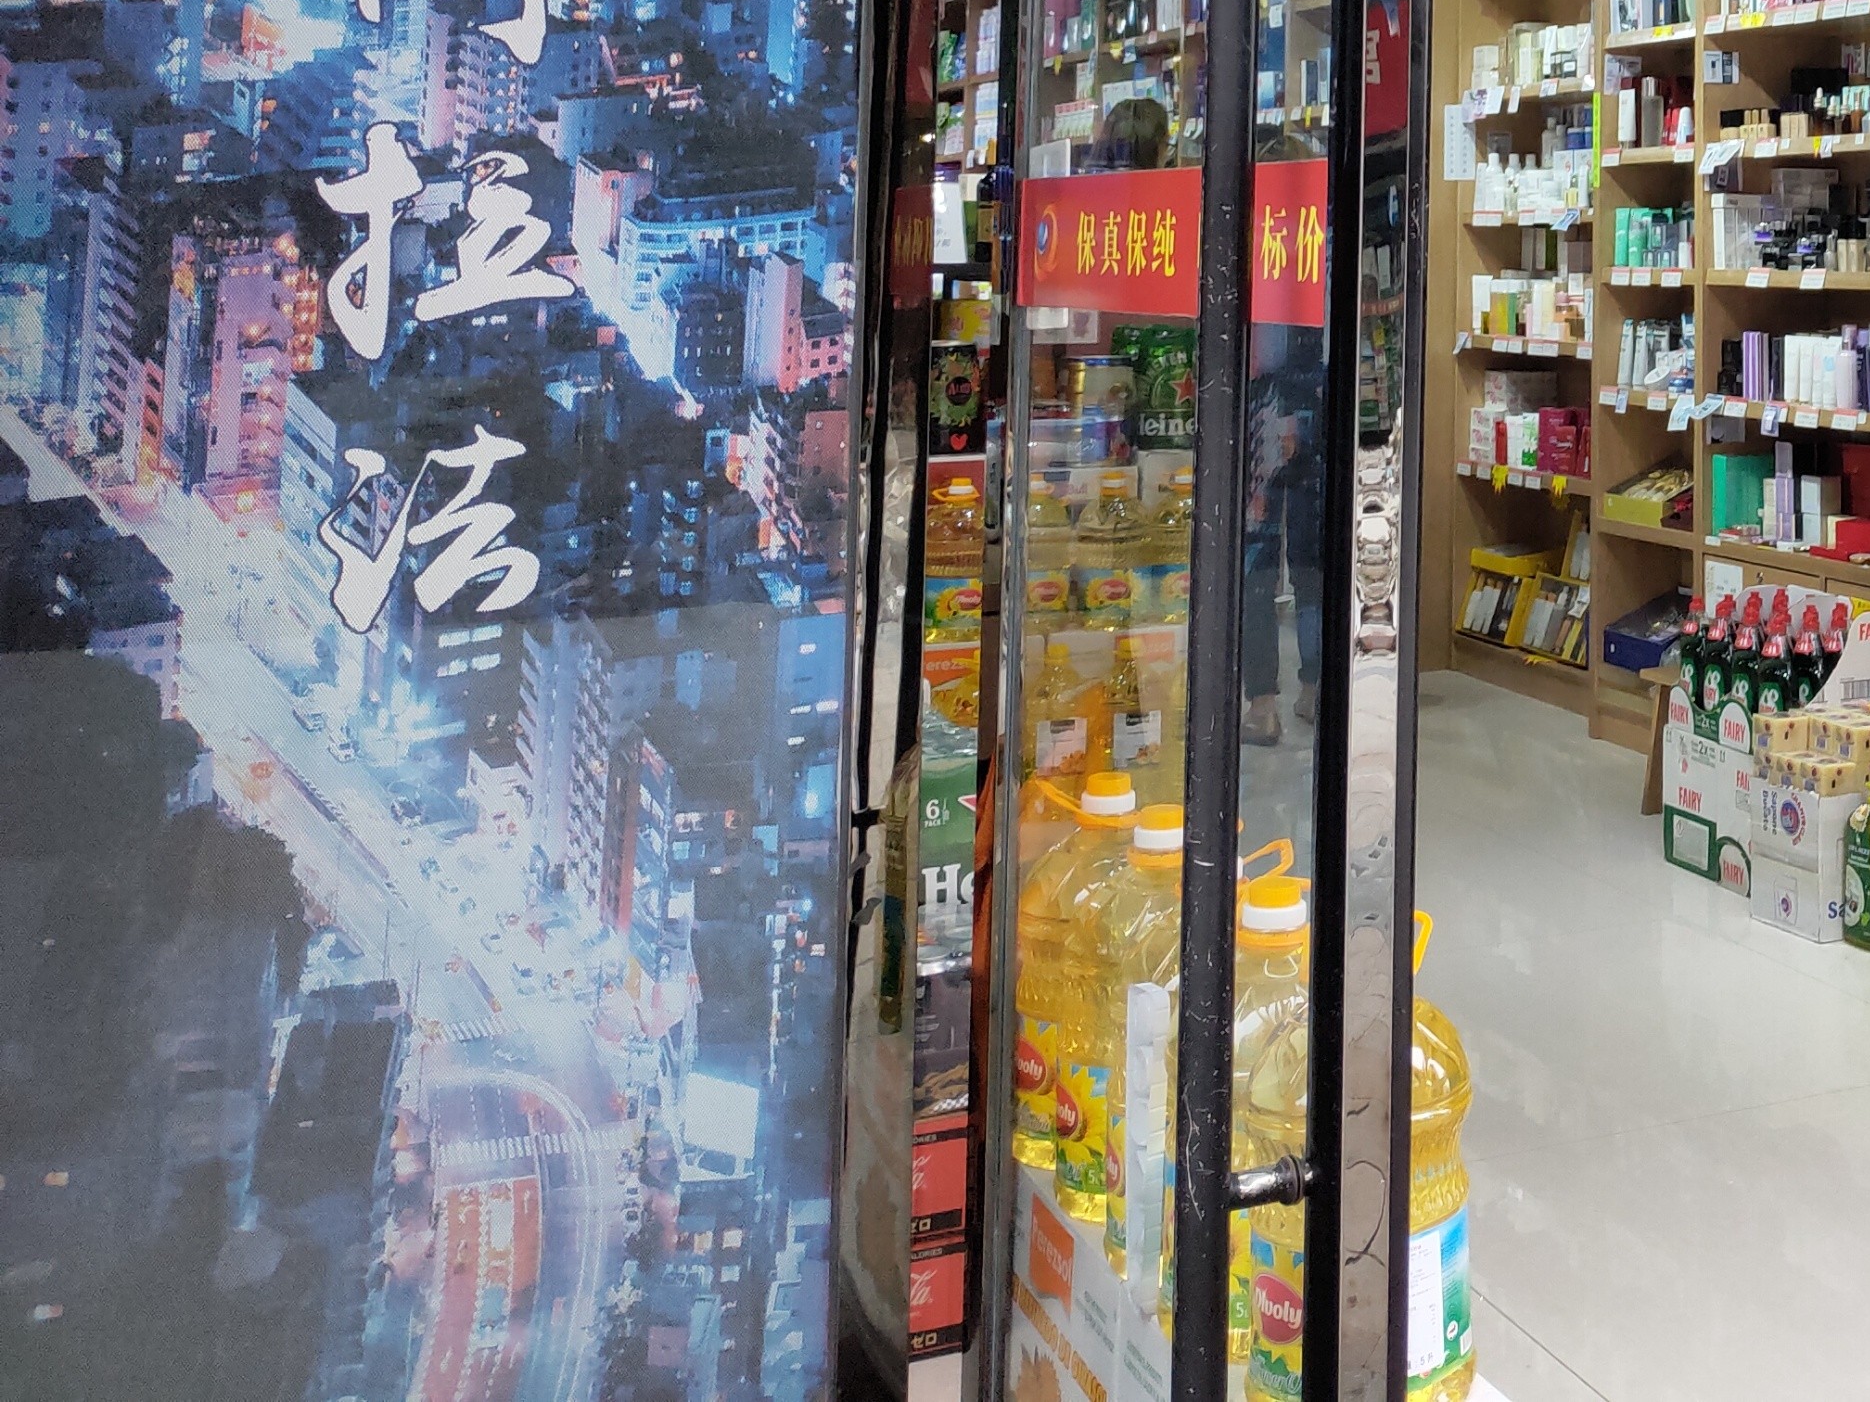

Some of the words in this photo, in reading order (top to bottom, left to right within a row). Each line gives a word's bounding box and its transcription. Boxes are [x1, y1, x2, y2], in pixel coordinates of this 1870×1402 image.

[1075, 207, 1178, 278] 保真保纯
[1670, 702, 1689, 725] FAIRY
[1724, 718, 1746, 744] FAIRY
[926, 799, 940, 819] 6
[1678, 786, 1702, 814] FAIRY
[1723, 860, 1745, 886] FAIRY
